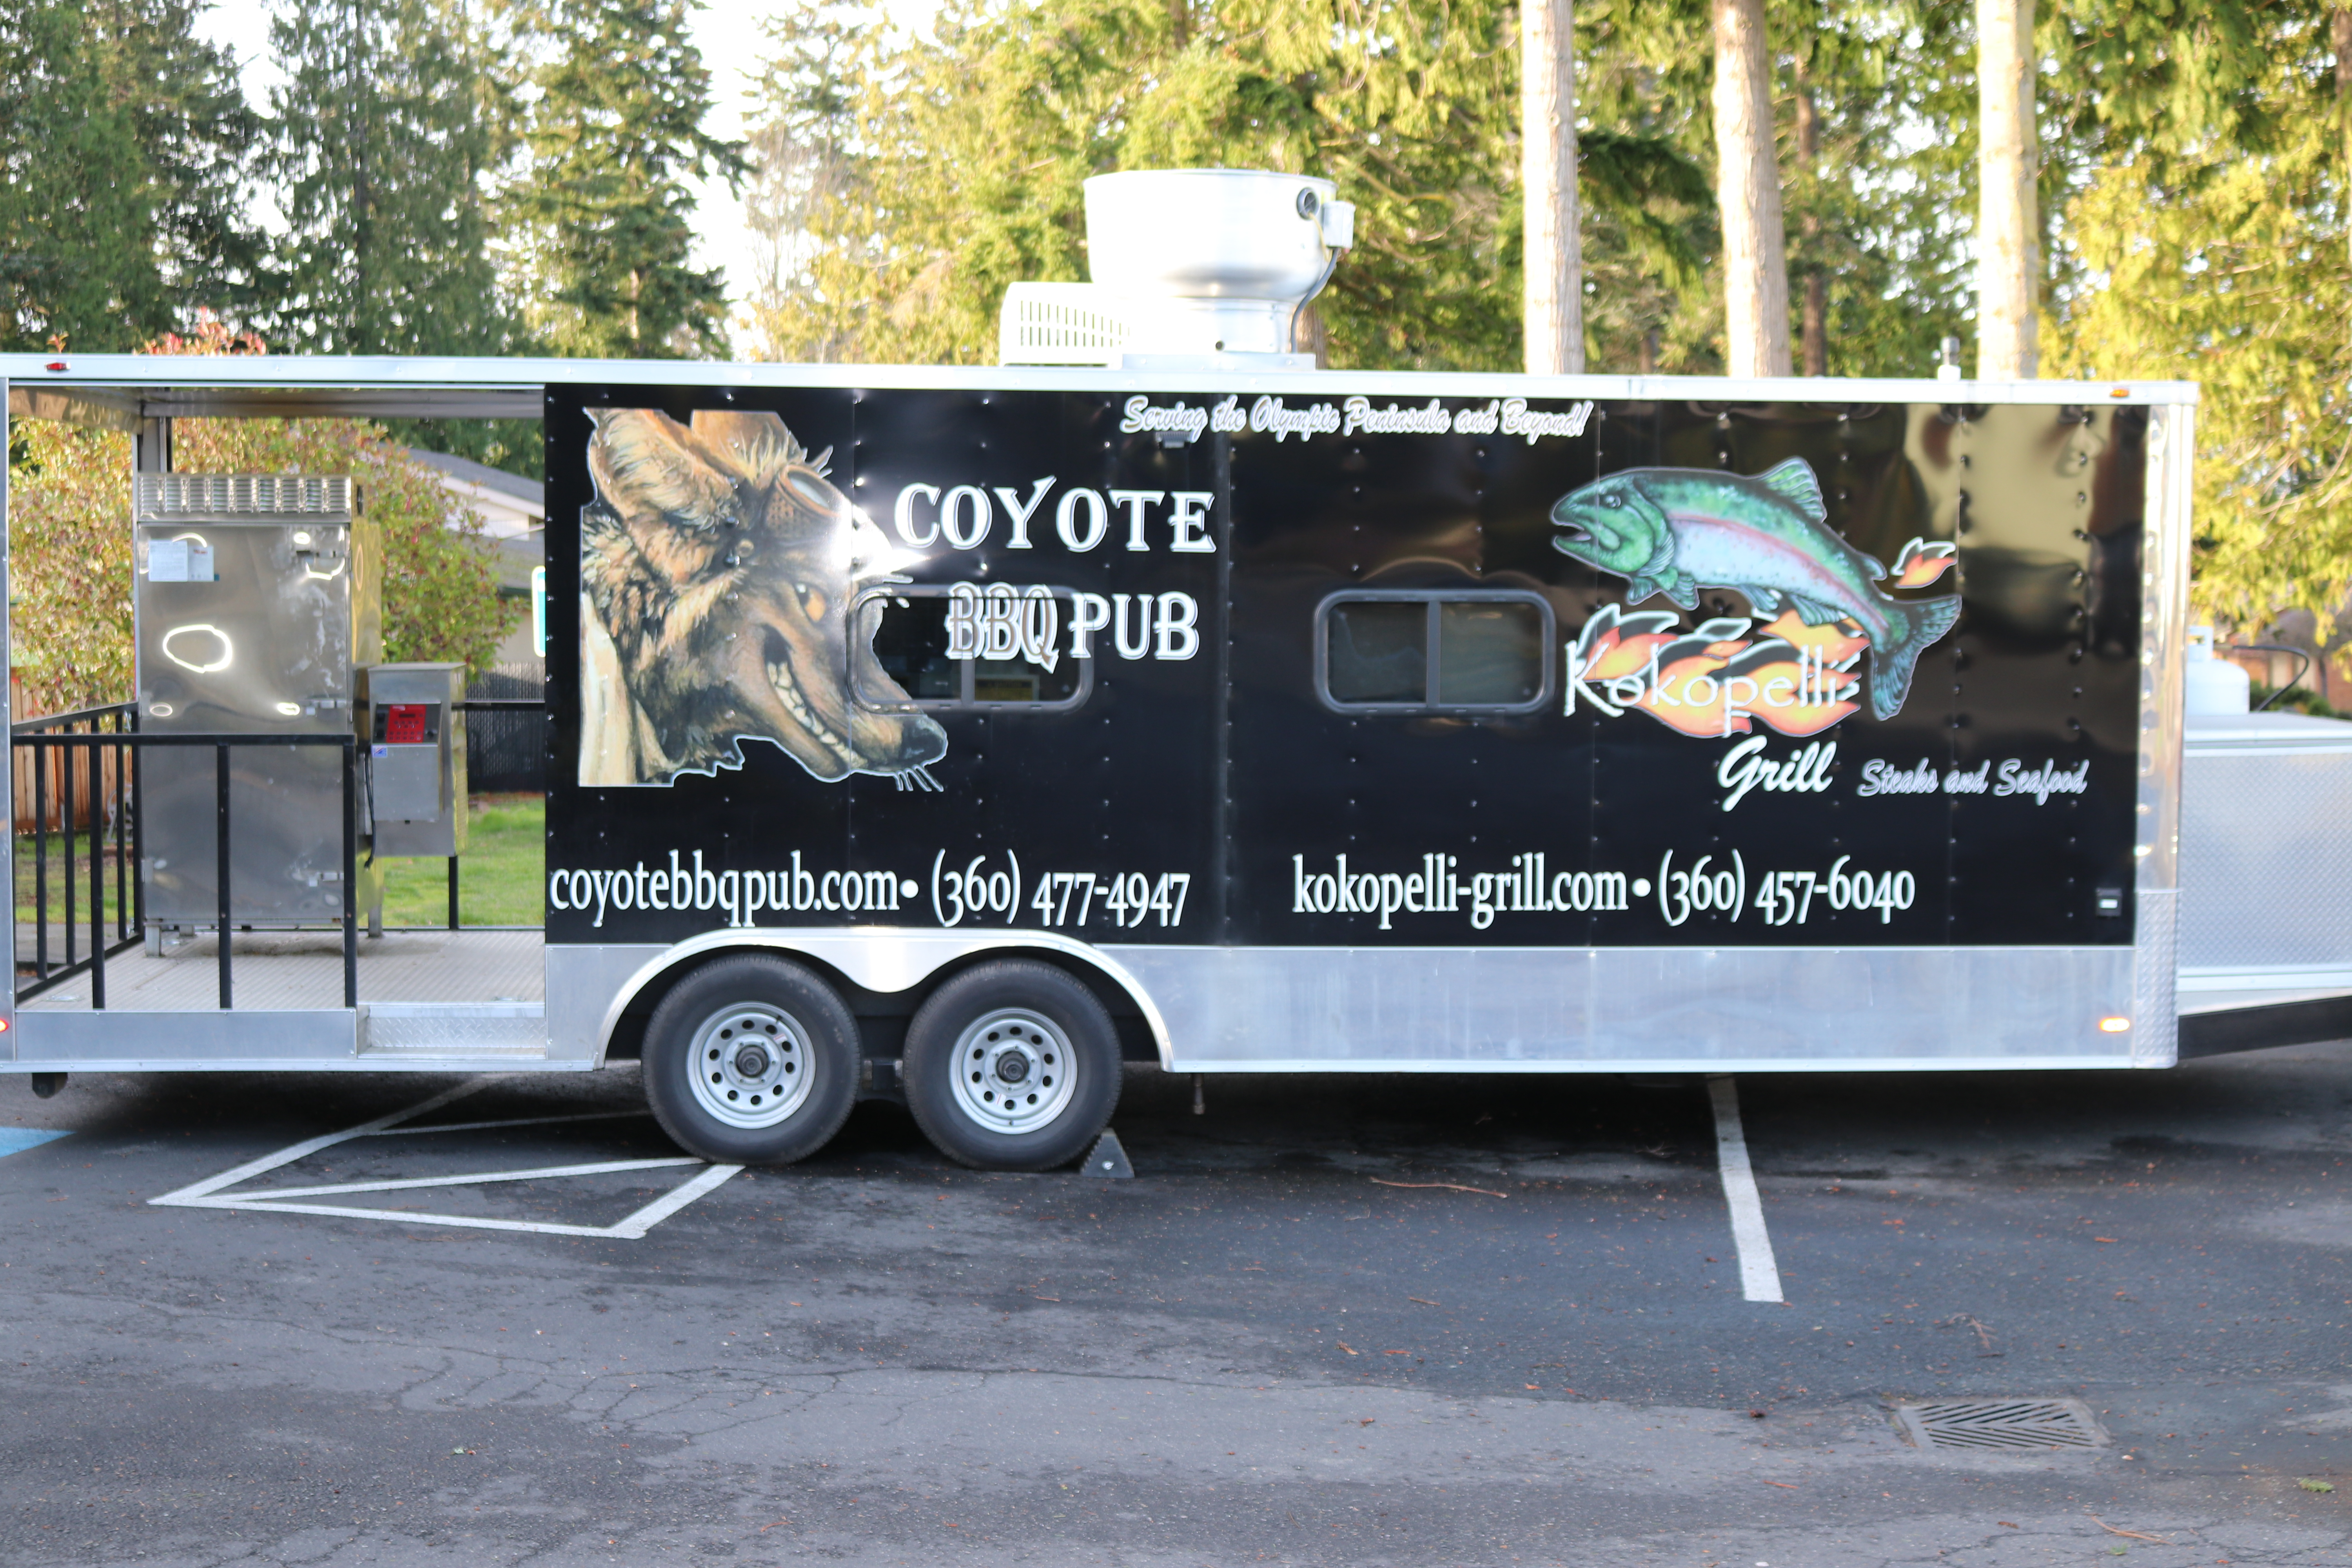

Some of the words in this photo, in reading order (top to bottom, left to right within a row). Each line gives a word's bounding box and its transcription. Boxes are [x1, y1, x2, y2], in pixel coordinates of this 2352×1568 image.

[1120, 395, 1209, 443] Serving
[1210, 394, 1247, 433] the
[1249, 395, 1341, 443] Olympic
[1343, 396, 1451, 436] Peninsula
[1453, 399, 1500, 435] and
[1500, 397, 1594, 445] Beyond!
[894, 475, 1216, 553] COYOTE
[944, 581, 1059, 674] BBQ
[1068, 591, 1200, 661] PUB
[1564, 640, 1837, 738] Kokopelli
[1718, 735, 1837, 812] Grill
[1857, 757, 1940, 797] Steaks
[1943, 759, 1991, 795] and
[1993, 758, 2090, 806] Seafood
[550, 848, 900, 929] coyotebbqpub.com
[931, 848, 1021, 927] (360)
[1031, 871, 1191, 929] 477-4947
[1292, 851, 1630, 930] kokopelli-grill.com
[1658, 848, 1746, 927] (360)
[1754, 854, 1916, 926] 457-6040
